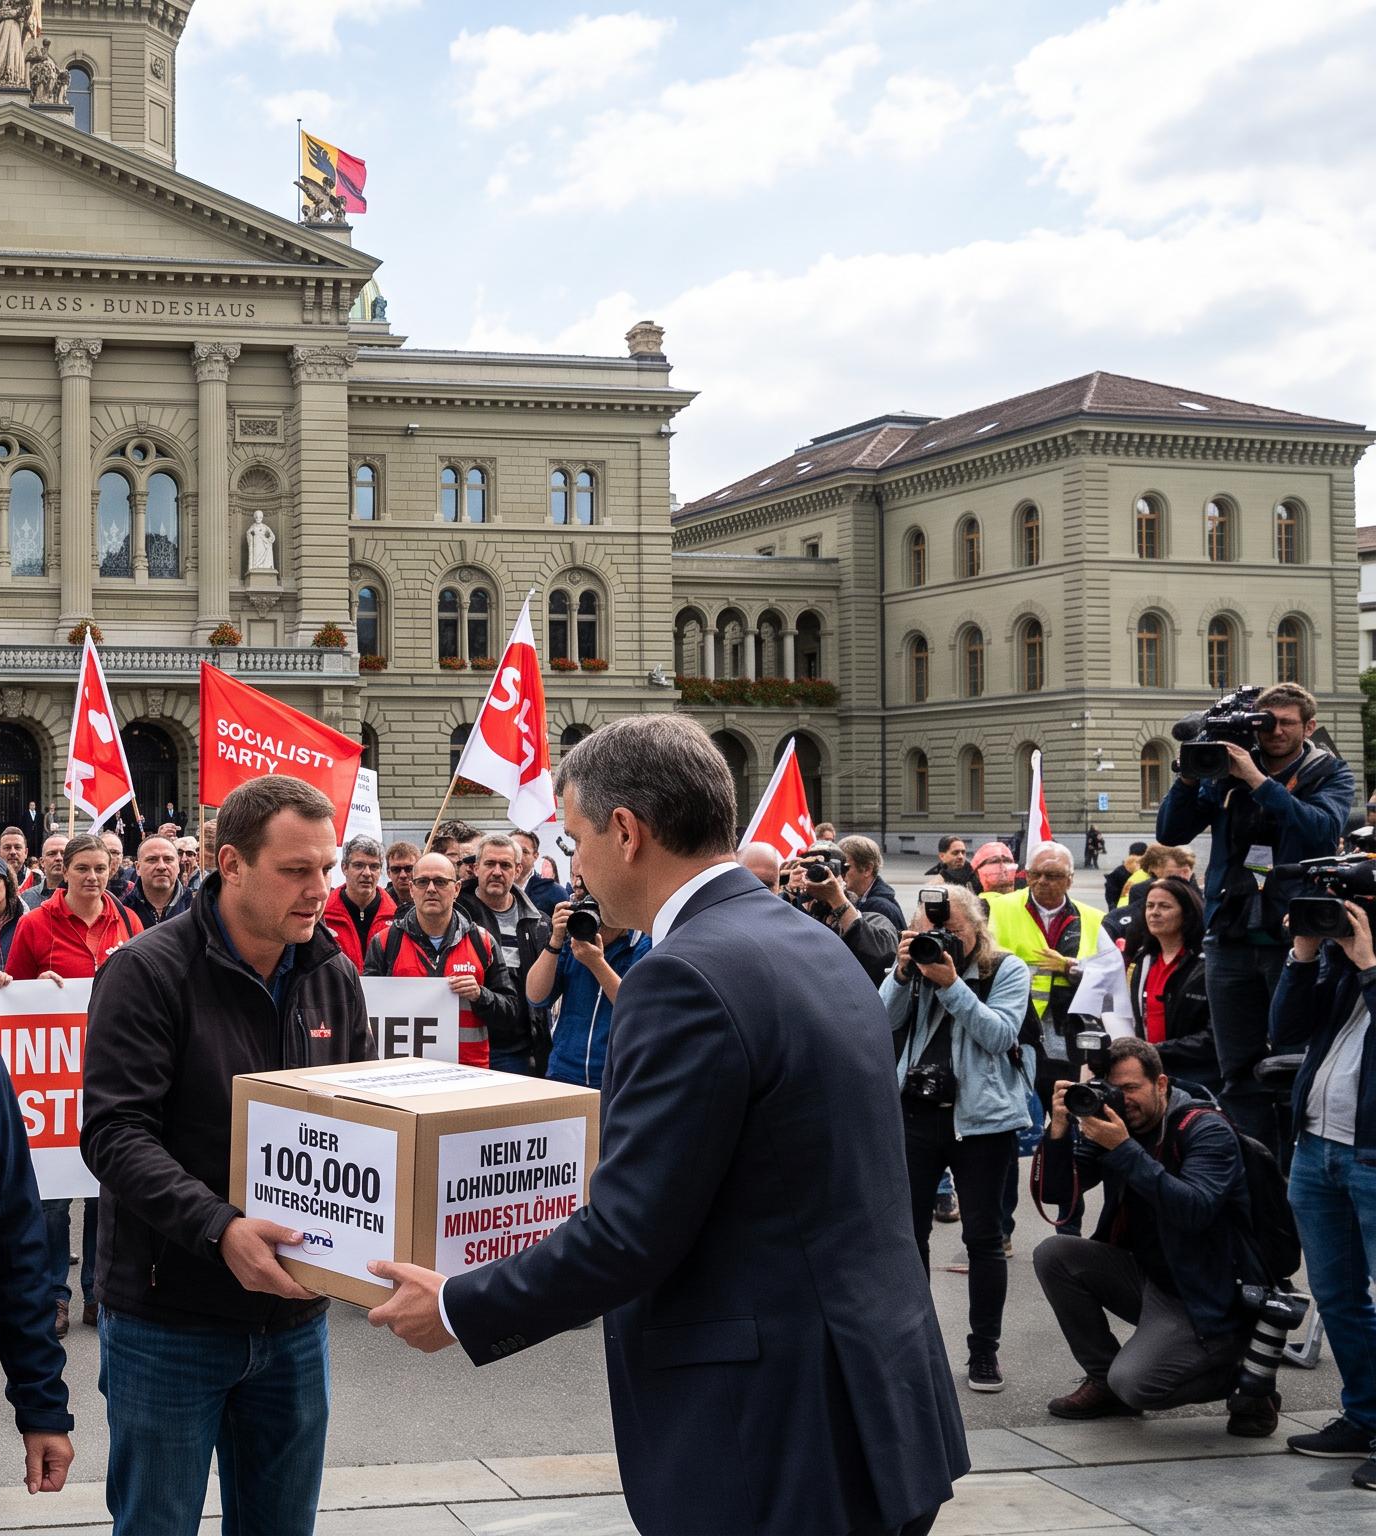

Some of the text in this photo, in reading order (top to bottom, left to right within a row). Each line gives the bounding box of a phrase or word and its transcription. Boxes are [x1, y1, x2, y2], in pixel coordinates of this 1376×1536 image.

[103, 298, 255, 318] BUNDESHAUS
[217, 741, 279, 774] PARTY
[298, 1122, 339, 1152] ÜBER
[480, 1136, 548, 1168] NEIN ZU
[260, 1143, 381, 1204] 100,000
[446, 1161, 577, 1204] LOHNDUMPING!
[254, 1182, 384, 1234] UNTERSCHRIFTEN
[444, 1194, 577, 1238] MINDESTLÖHNE
